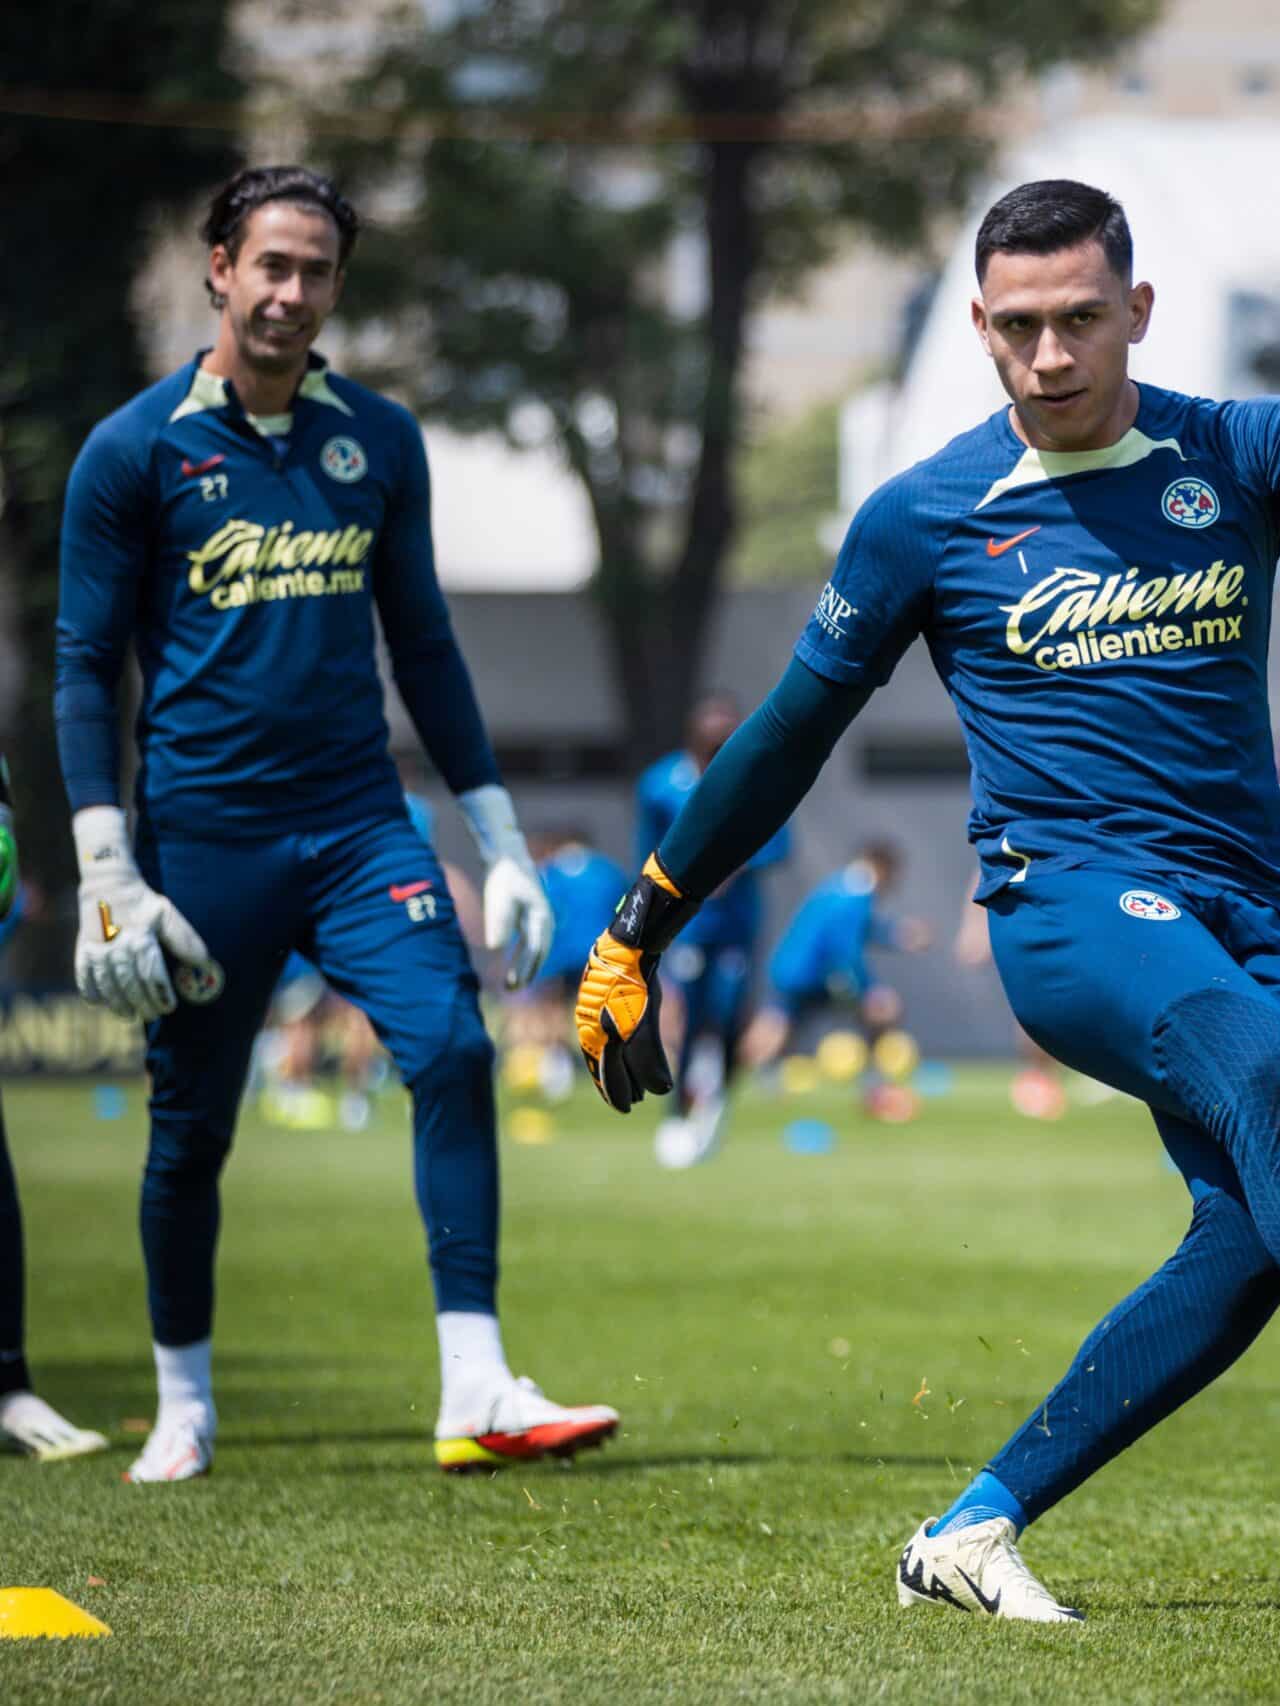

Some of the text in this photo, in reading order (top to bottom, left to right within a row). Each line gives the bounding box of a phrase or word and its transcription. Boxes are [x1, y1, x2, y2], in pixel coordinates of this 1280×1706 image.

[200, 474, 229, 502] 27
[187, 518, 374, 594] Caliente
[210, 567, 365, 611] caliente.mx
[998, 559, 1245, 656] Caliente
[1034, 614, 1243, 672] caliente.mx
[405, 894, 437, 923] 27
